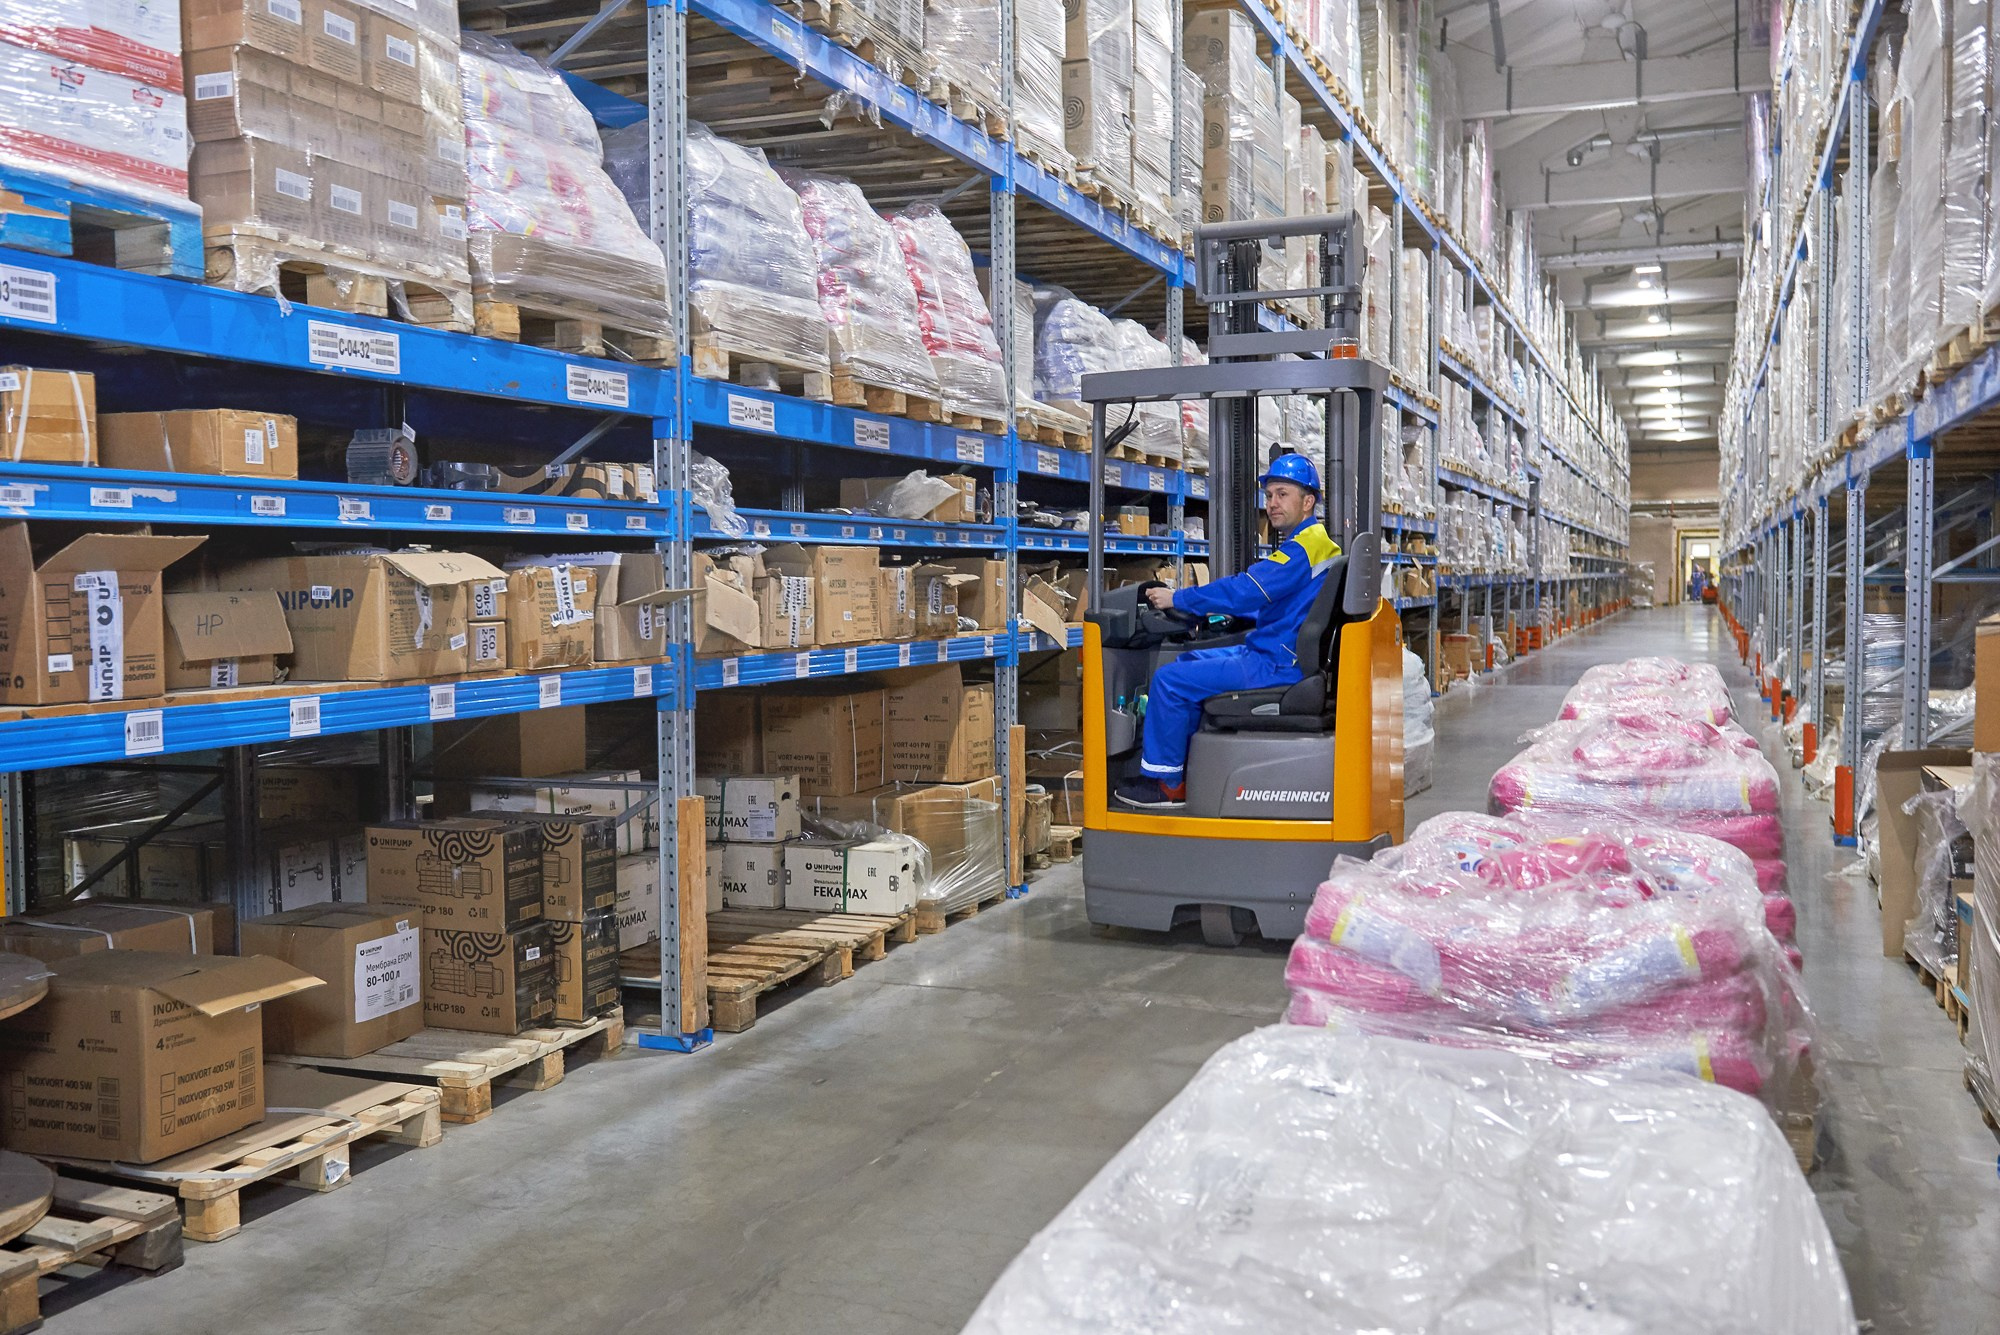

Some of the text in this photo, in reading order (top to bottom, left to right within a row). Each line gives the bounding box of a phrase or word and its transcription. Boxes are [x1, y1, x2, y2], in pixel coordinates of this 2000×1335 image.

[126, 61, 168, 79] FRESHNESS
[338, 337, 371, 359] C-04-32
[587, 378, 610, 396] C-04-31
[277, 588, 355, 611] NIPUMP
[475, 593, 484, 616] ECO
[483, 585, 491, 616] 2-100
[197, 614, 224, 636] HP
[481, 628, 489, 659] 2-100
[488, 627, 496, 650] ECO
[1235, 786, 1331, 803] JUNGHEINRICH
[571, 804, 592, 814] UNIPUMP
[379, 839, 413, 848] UNIPUMP
[723, 881, 747, 893] MAX
[813, 886, 868, 900] FEKAMAX
[438, 906, 454, 917] 180
[365, 945, 383, 955] UNIPUMP
[366, 957, 398, 974] Мембрана
[433, 1002, 450, 1013] HCP
[450, 1003, 466, 1015] 180
[78, 1038, 86, 1051] 4
[156, 1037, 165, 1051] 4
[177, 1060, 237, 1085] INOXVORT 400 SW
[27, 1076, 92, 1091] INOXVORT 400 SW
[177, 1080, 235, 1106] INOXVORT 750 SW
[28, 1096, 93, 1113] INOXVORT 750 SW
[226, 1099, 237, 1112] SW
[28, 1118, 65, 1131] INOXVORT
[83, 1122, 96, 1134] SW
